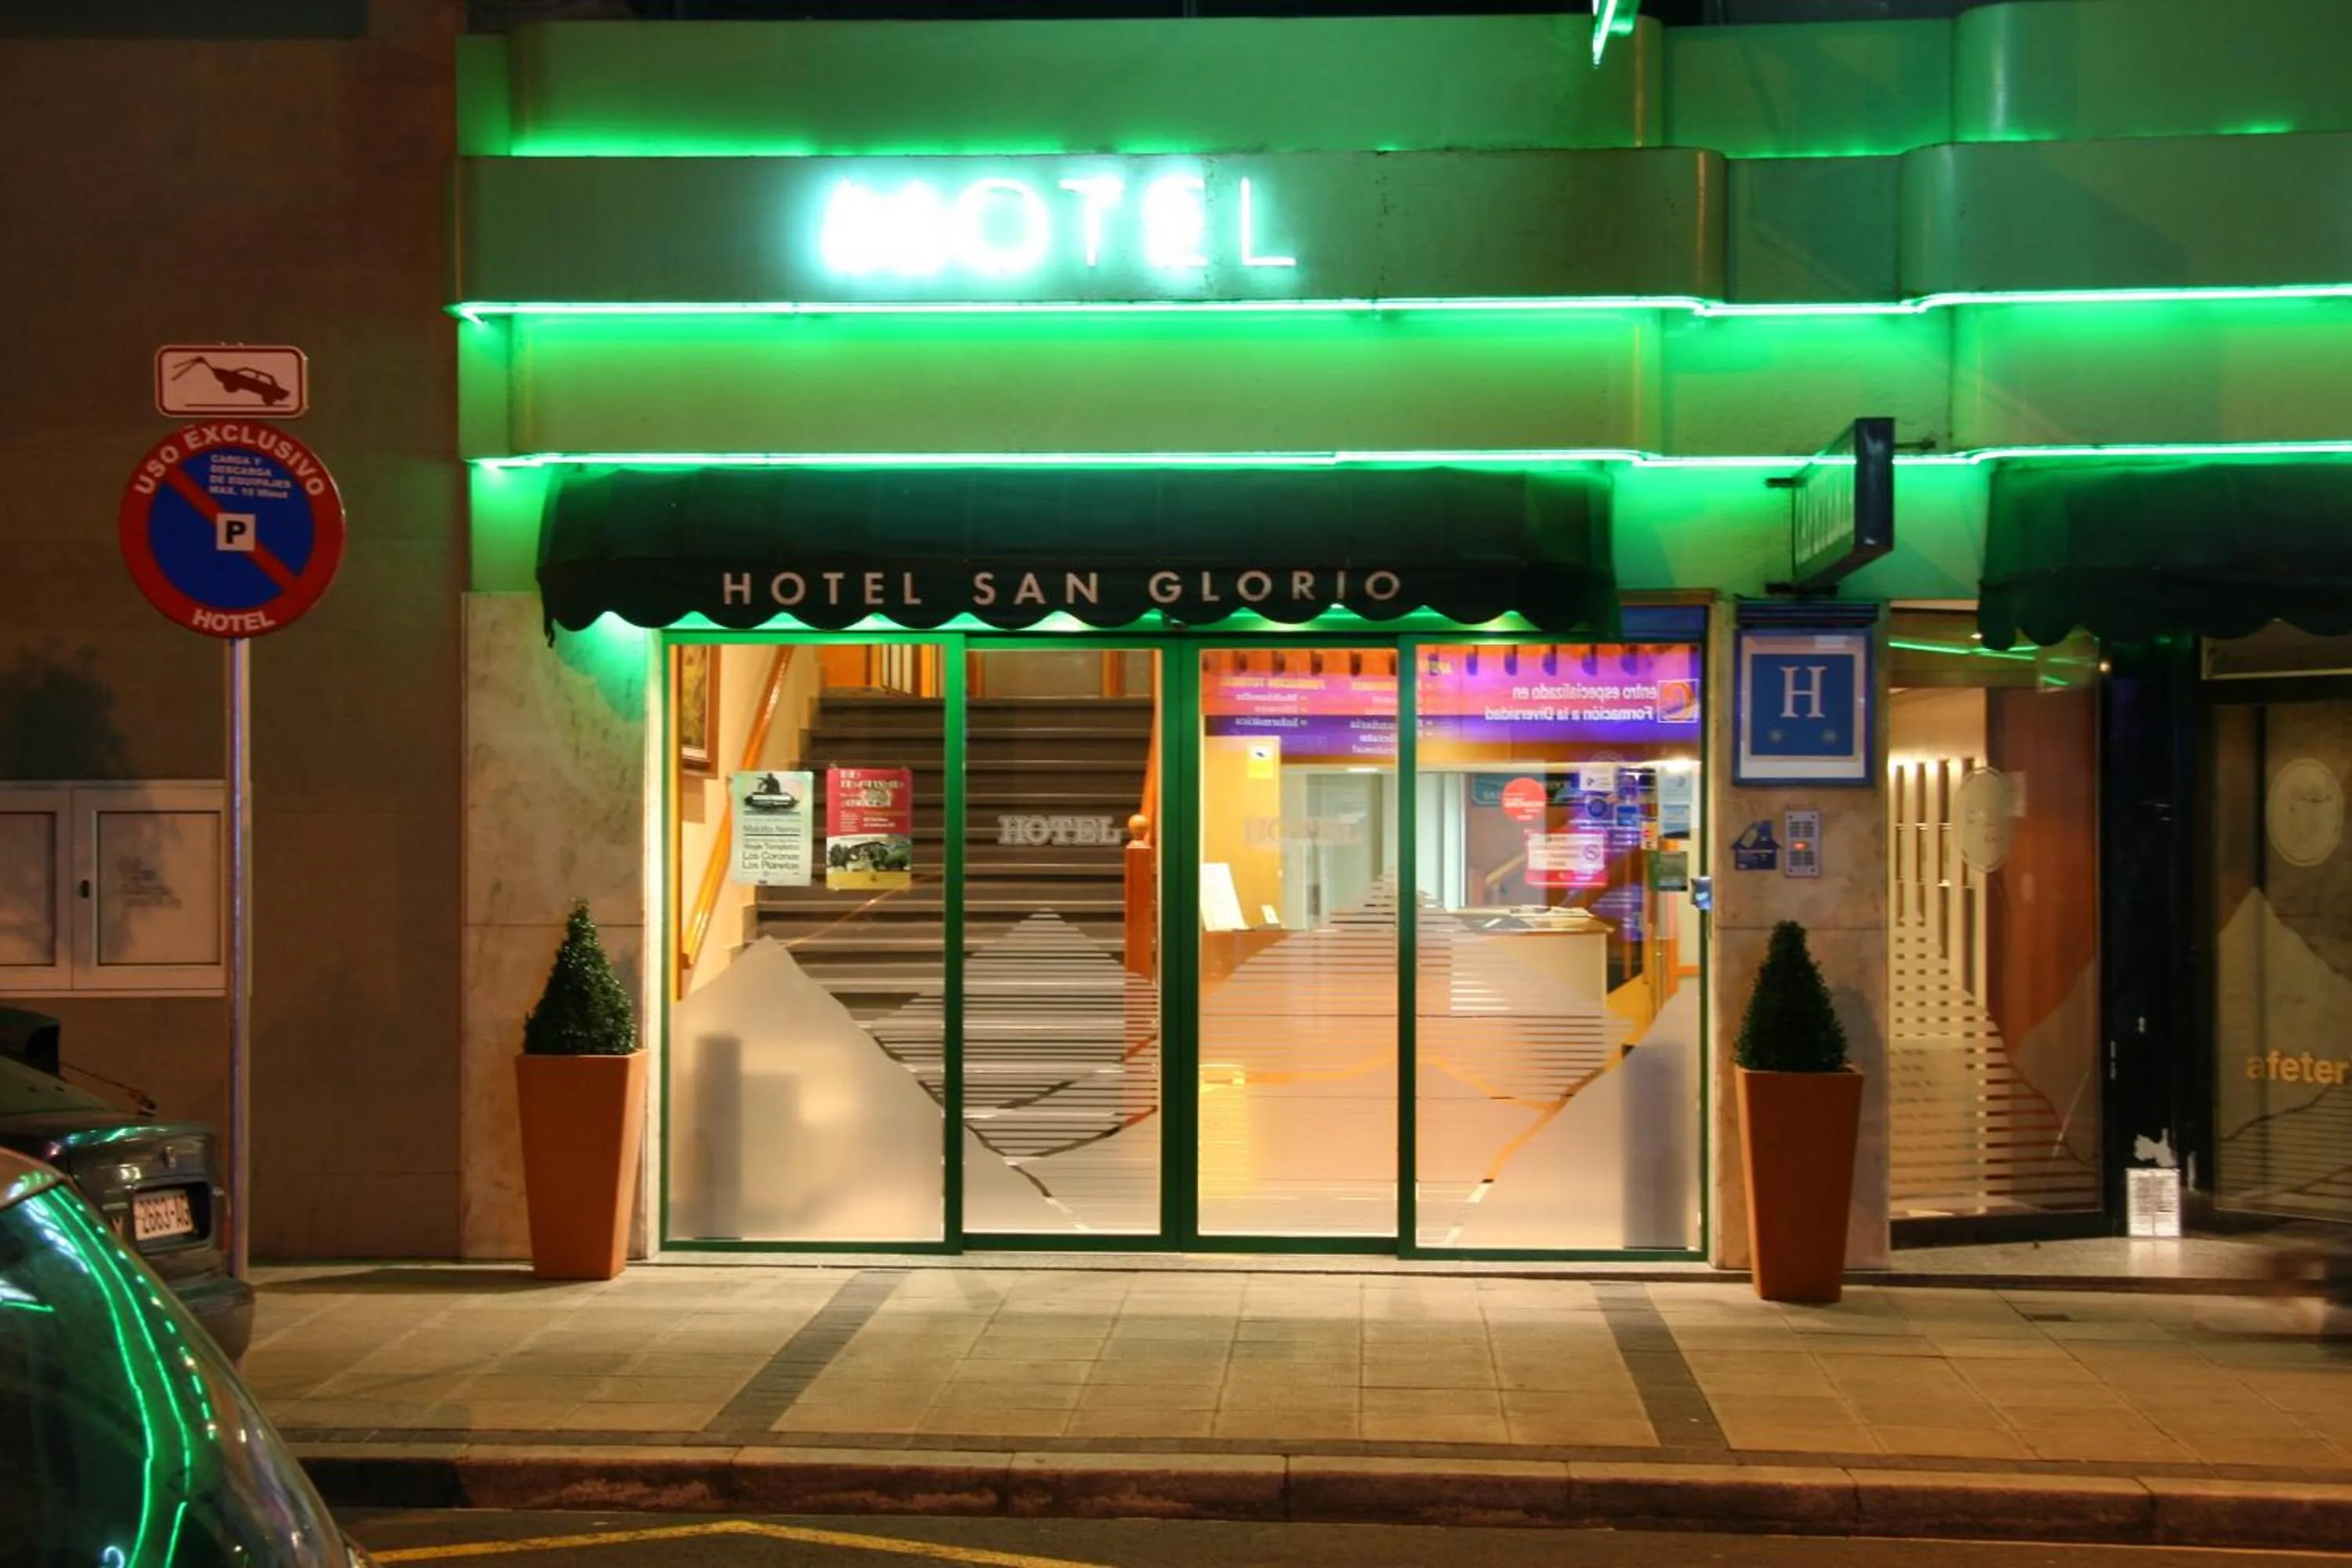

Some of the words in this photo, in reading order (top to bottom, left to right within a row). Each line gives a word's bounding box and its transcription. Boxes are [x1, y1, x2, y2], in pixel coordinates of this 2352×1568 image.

[135, 445, 180, 494] USO
[183, 424, 325, 495] EXCLUSIVO
[225, 520, 247, 544] P
[723, 572, 922, 605] HOTEL
[972, 571, 1098, 605] SAN
[1148, 570, 1401, 604] GLORIO
[192, 608, 276, 632] HOTEL
[1779, 666, 1828, 718] H
[997, 815, 1122, 845] HOTEL
[2245, 1049, 2352, 1084] afeter
